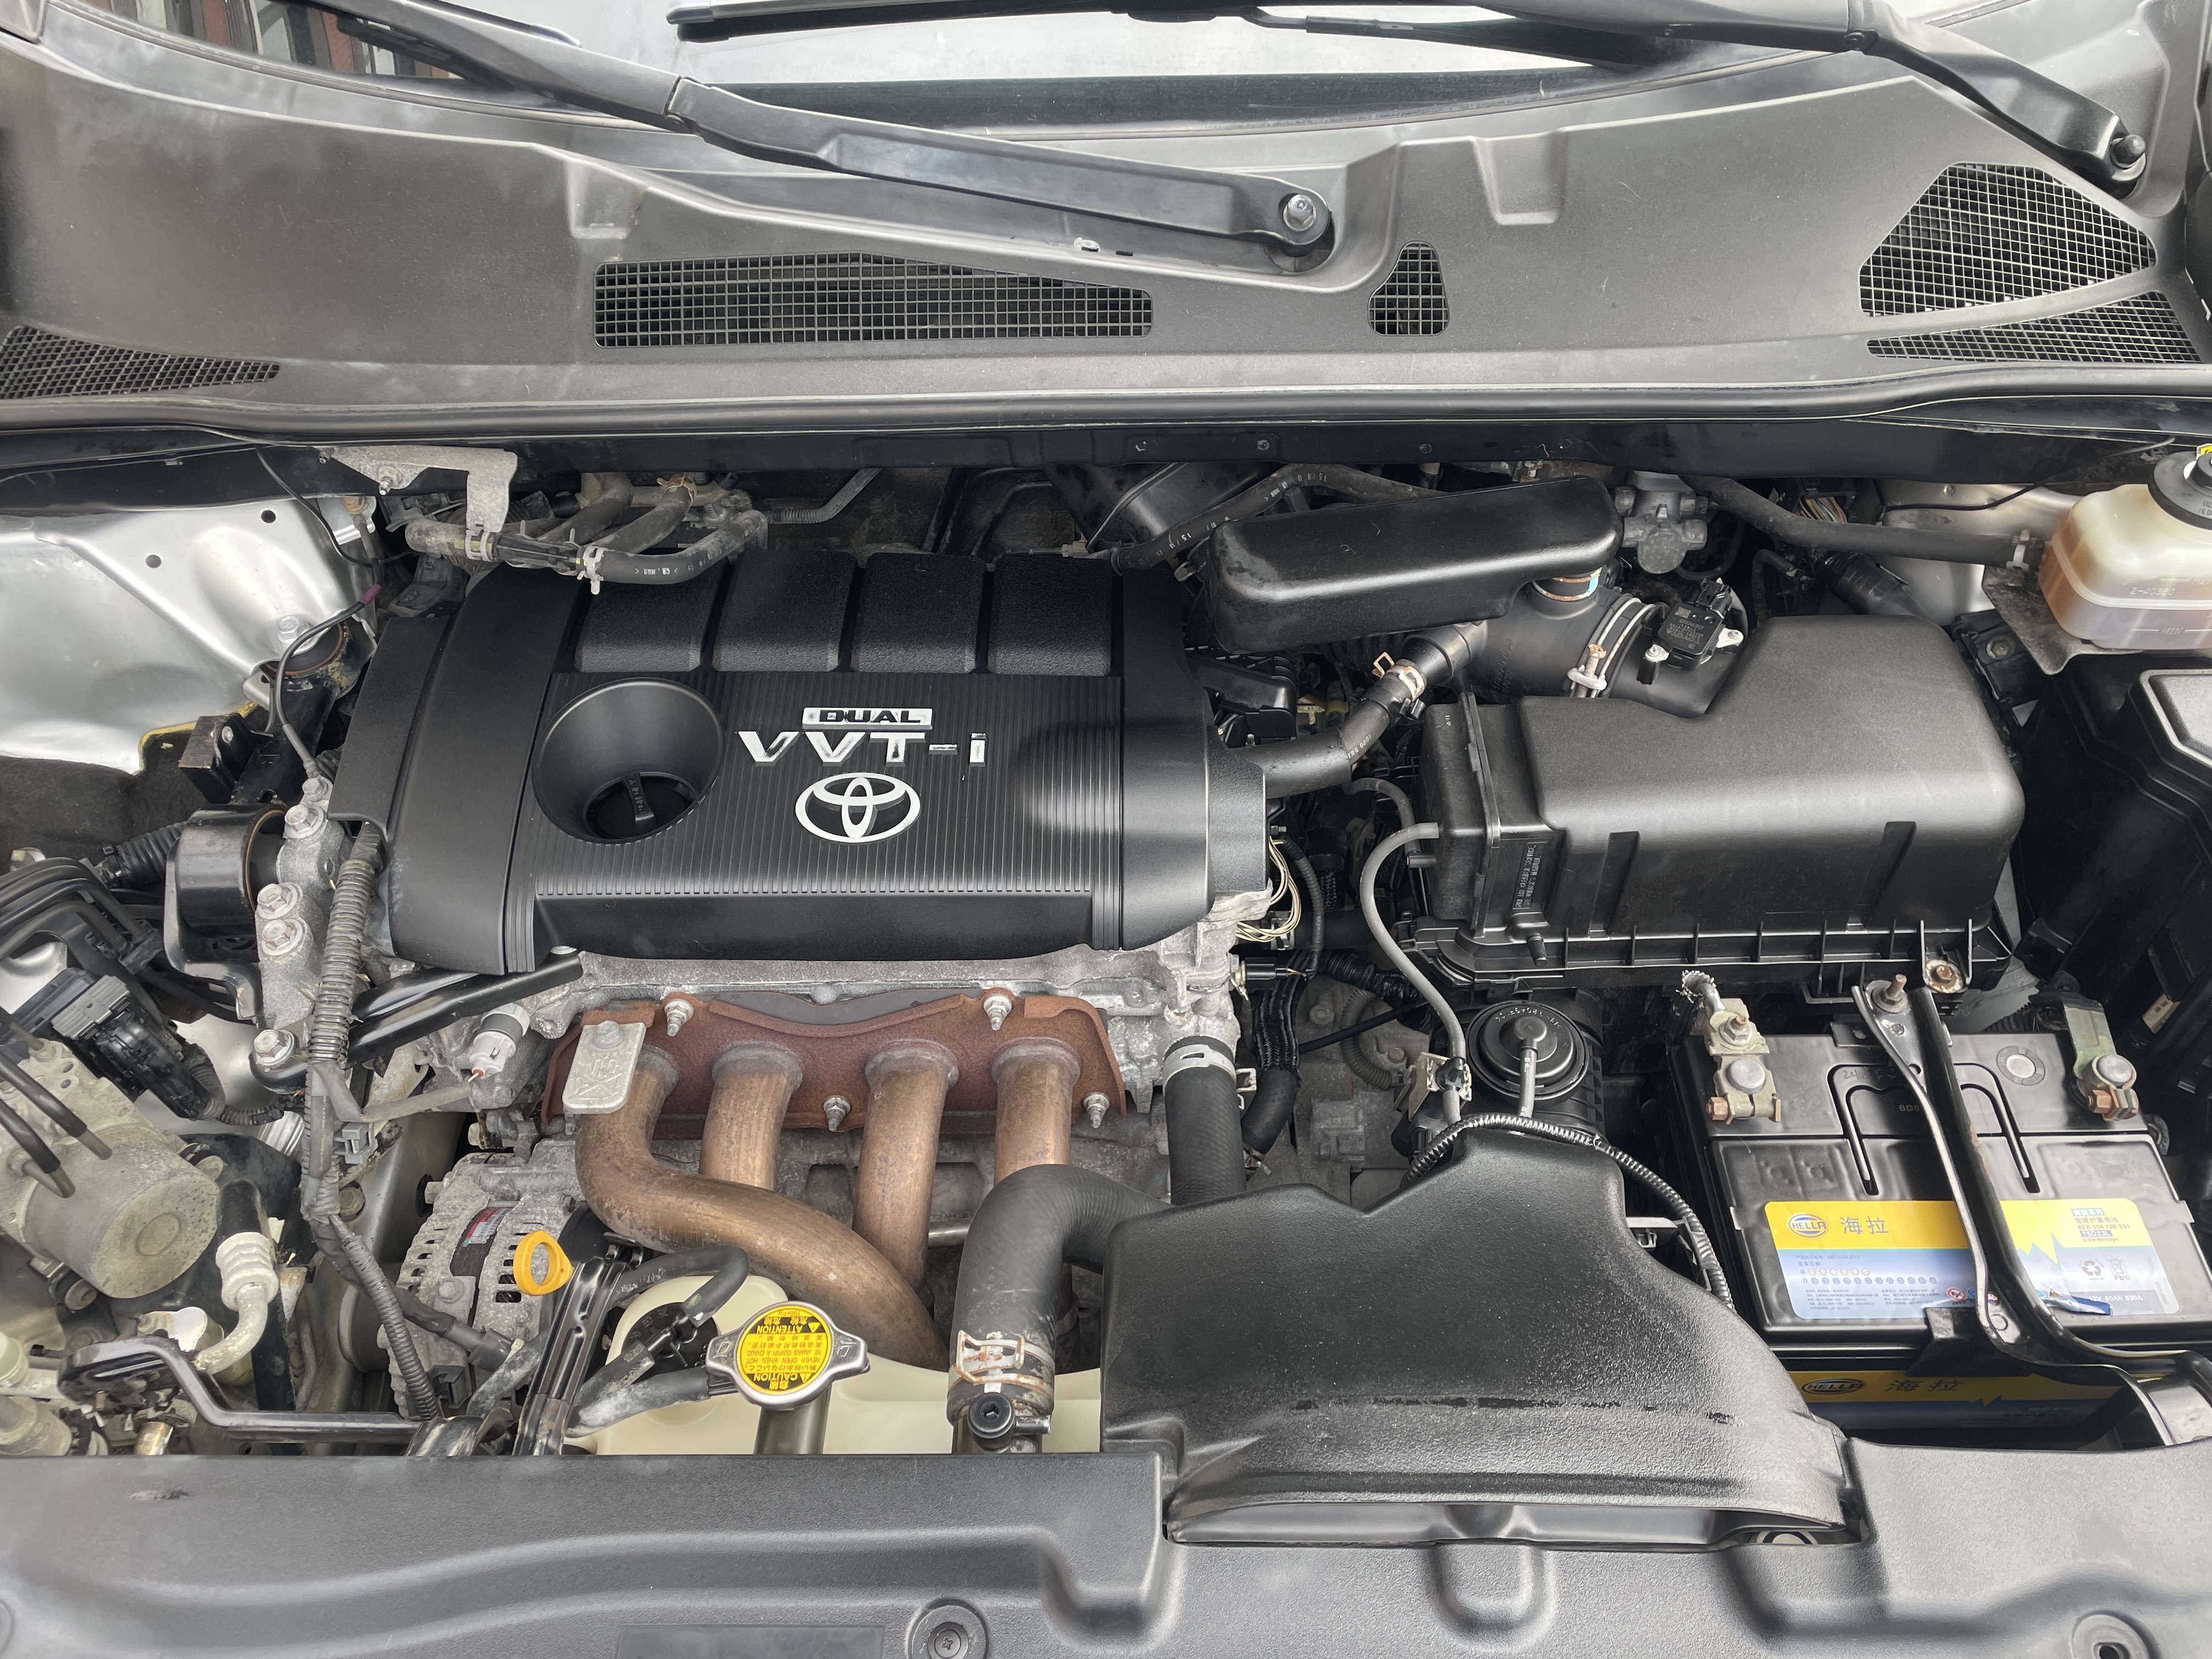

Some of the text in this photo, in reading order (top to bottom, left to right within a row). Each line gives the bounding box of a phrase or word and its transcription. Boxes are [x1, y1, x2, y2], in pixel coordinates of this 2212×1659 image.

[820, 710, 921, 723] DUAL
[738, 731, 986, 766] VVT-i
[1792, 1221, 1827, 1230] HELLA
[1839, 1216, 1889, 1234] 海拉
[757, 1325, 803, 1334] ATTENTION
[754, 1373, 798, 1381] CAUTION
[1884, 1380, 1964, 1392] 海拉
